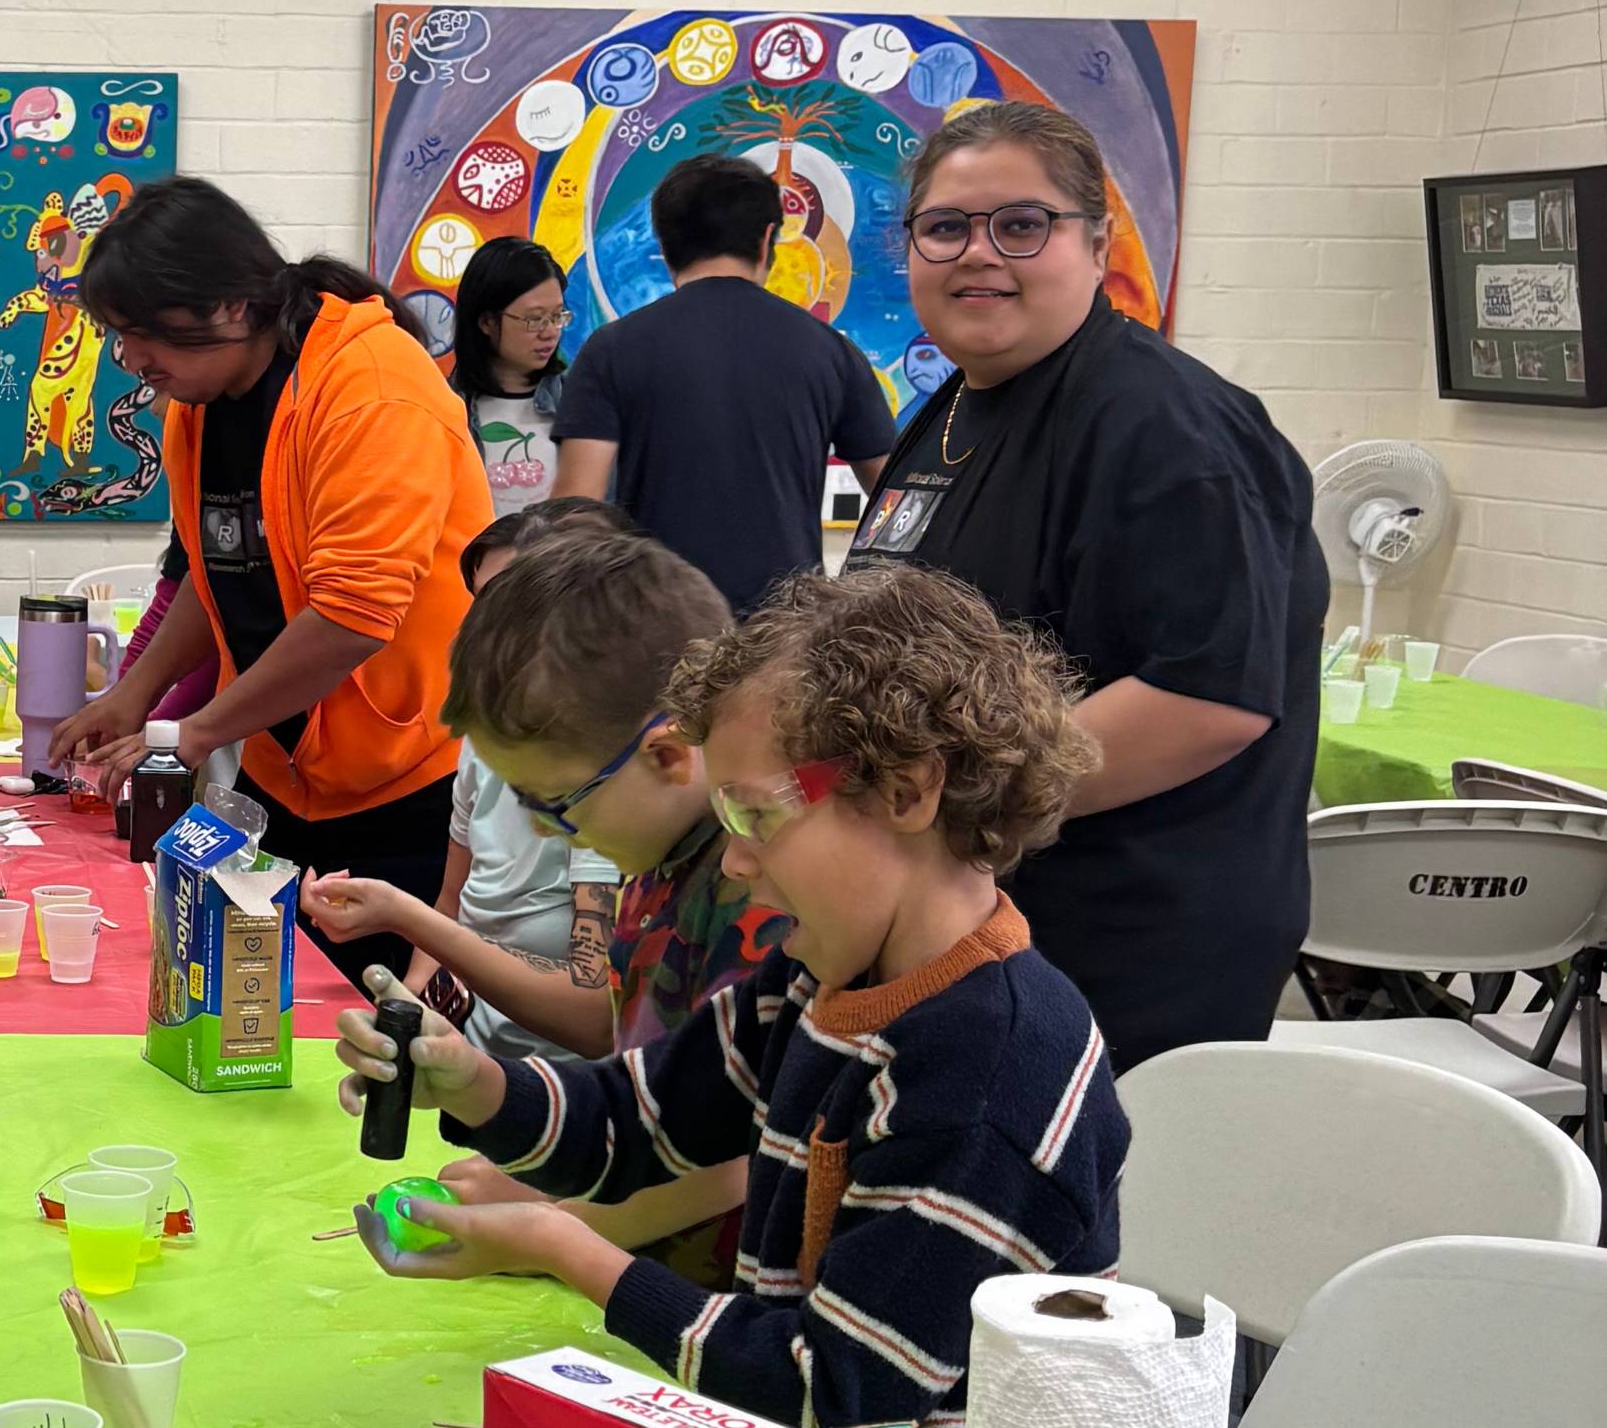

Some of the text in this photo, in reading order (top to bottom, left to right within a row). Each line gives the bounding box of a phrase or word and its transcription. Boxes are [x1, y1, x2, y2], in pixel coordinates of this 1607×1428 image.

[894, 510, 911, 532] R
[217, 525, 233, 543] R
[173, 818, 220, 859] Ziploc
[1409, 874, 1528, 898] CENTRO
[175, 882, 191, 961] Ziploc
[216, 1062, 283, 1077] SANDWICH
[605, 1397, 657, 1422] TEAM
